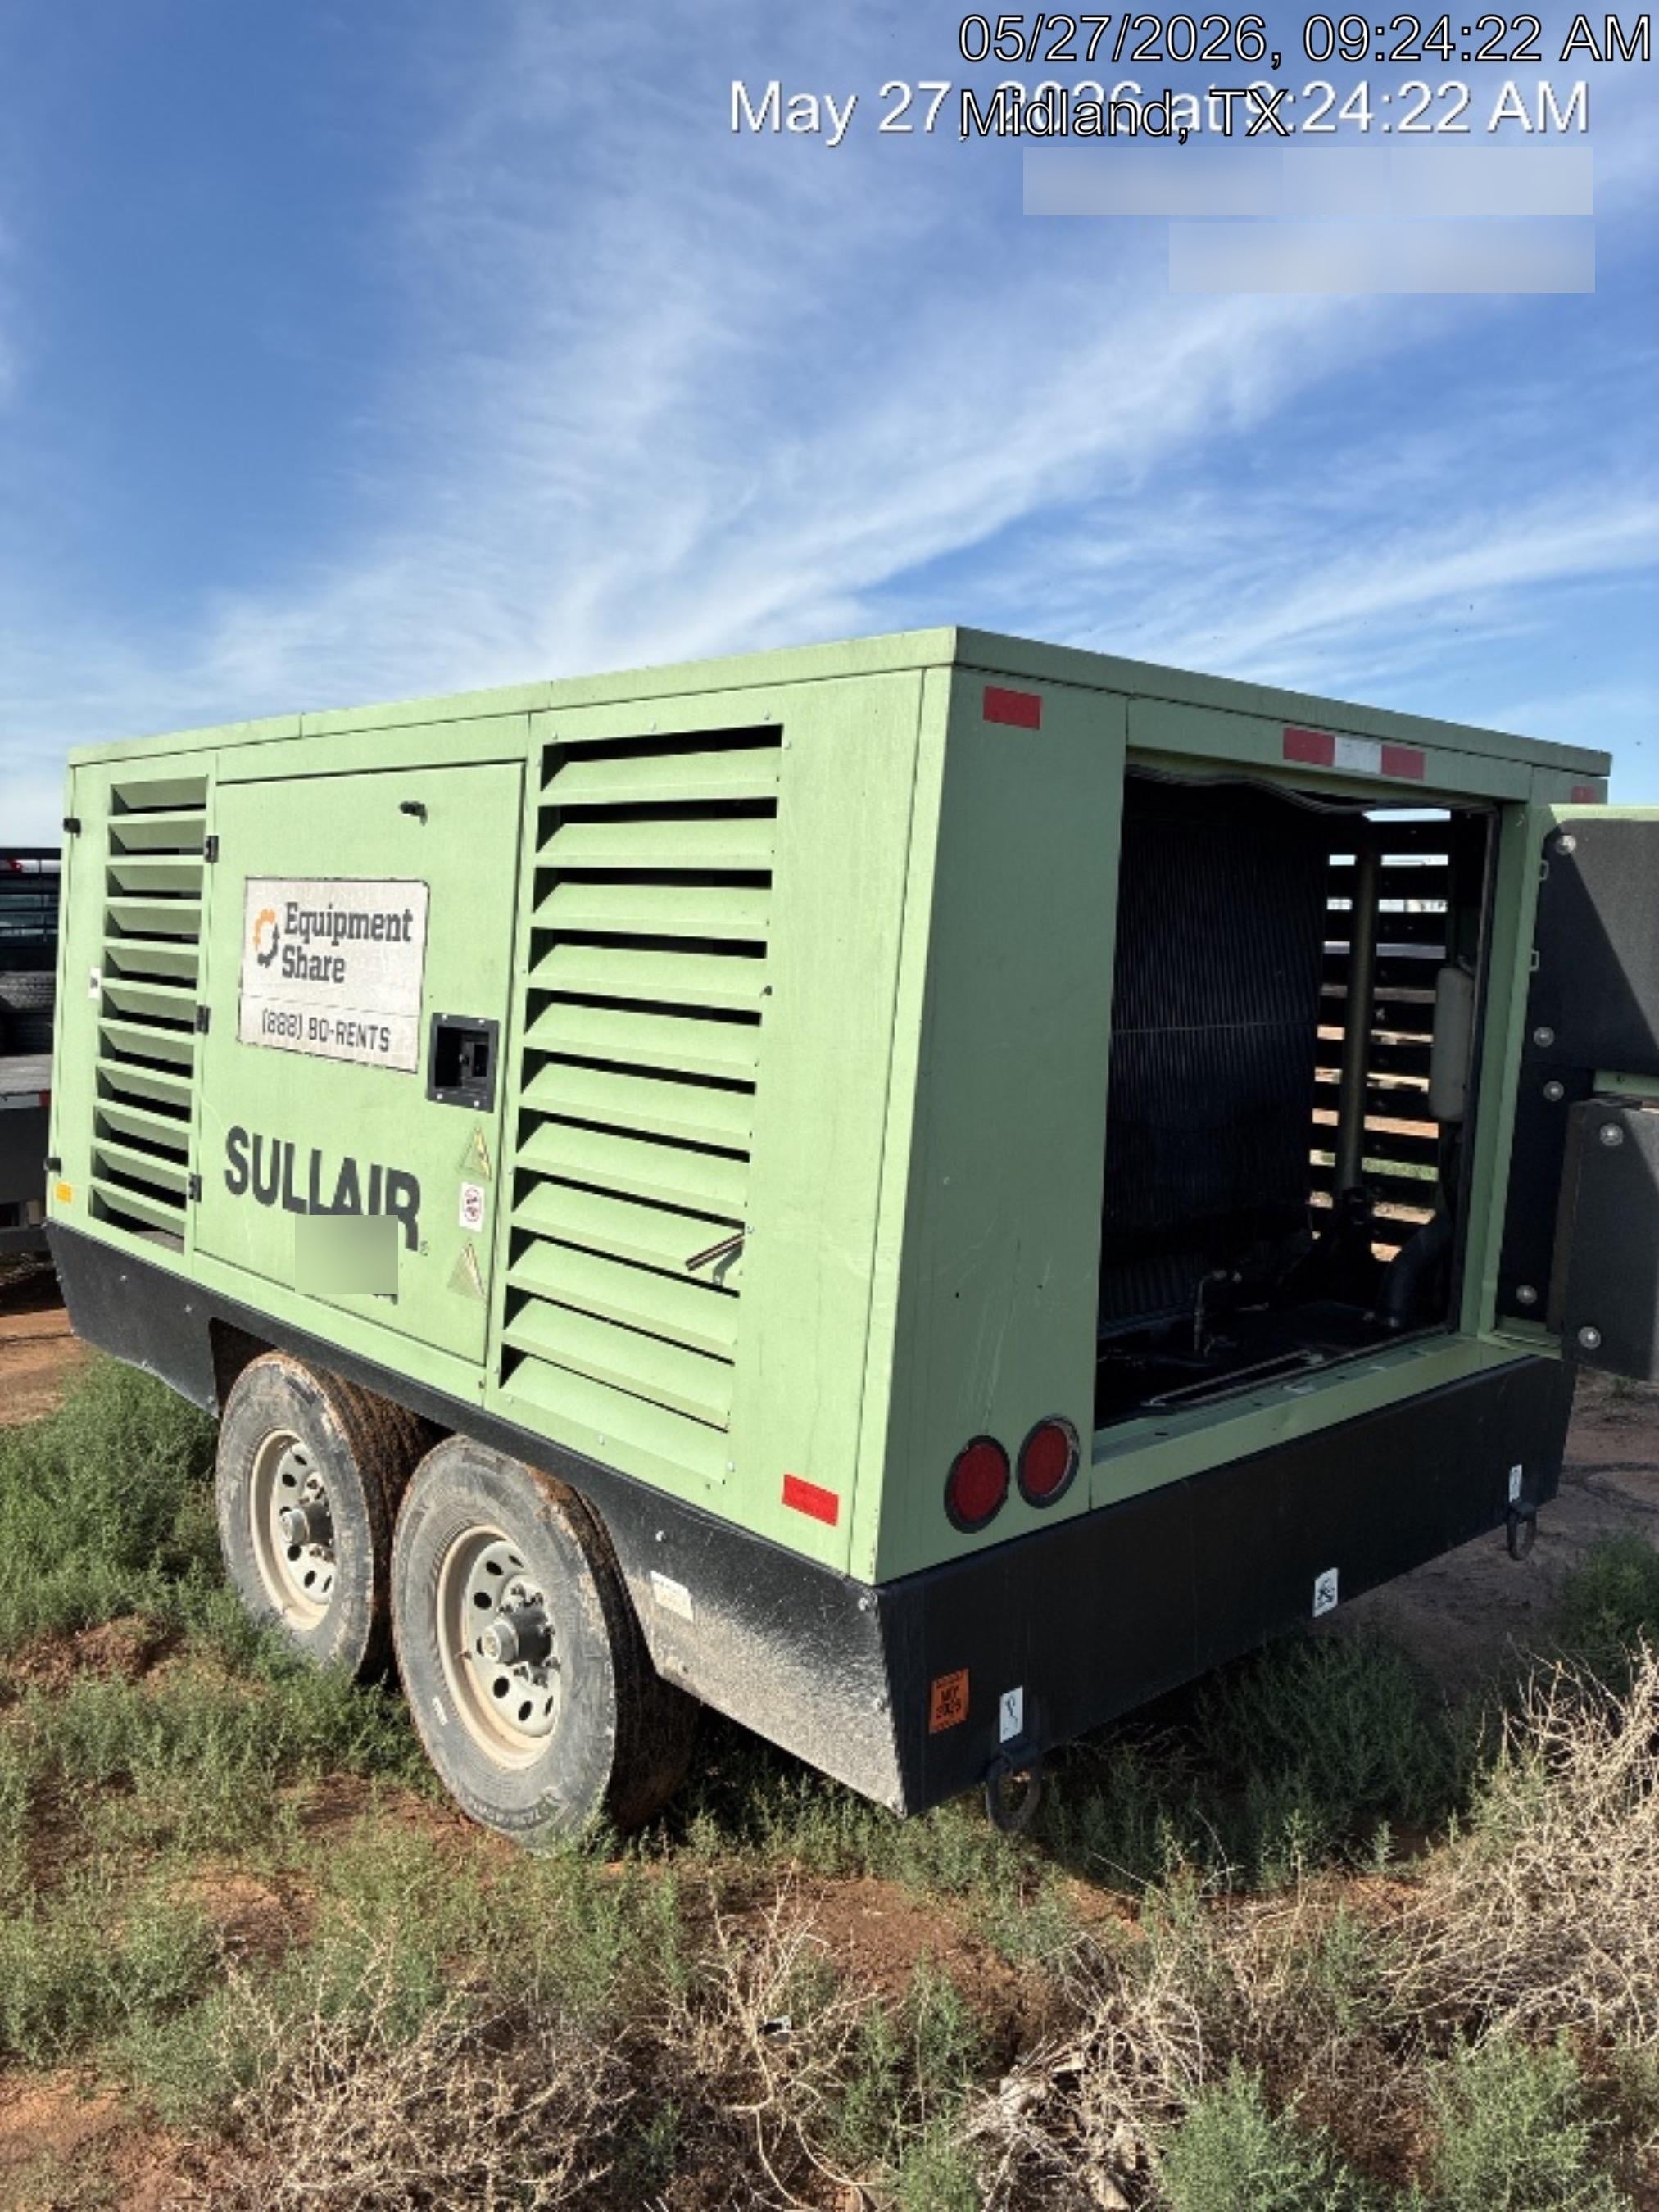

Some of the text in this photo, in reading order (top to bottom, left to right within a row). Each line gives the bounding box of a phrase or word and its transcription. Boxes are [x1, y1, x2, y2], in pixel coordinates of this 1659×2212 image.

[283, 901, 414, 947] Equipment
[281, 944, 346, 984] Share
[262, 1008, 303, 1040] (888)
[224, 1125, 421, 1252] SULLAIR
